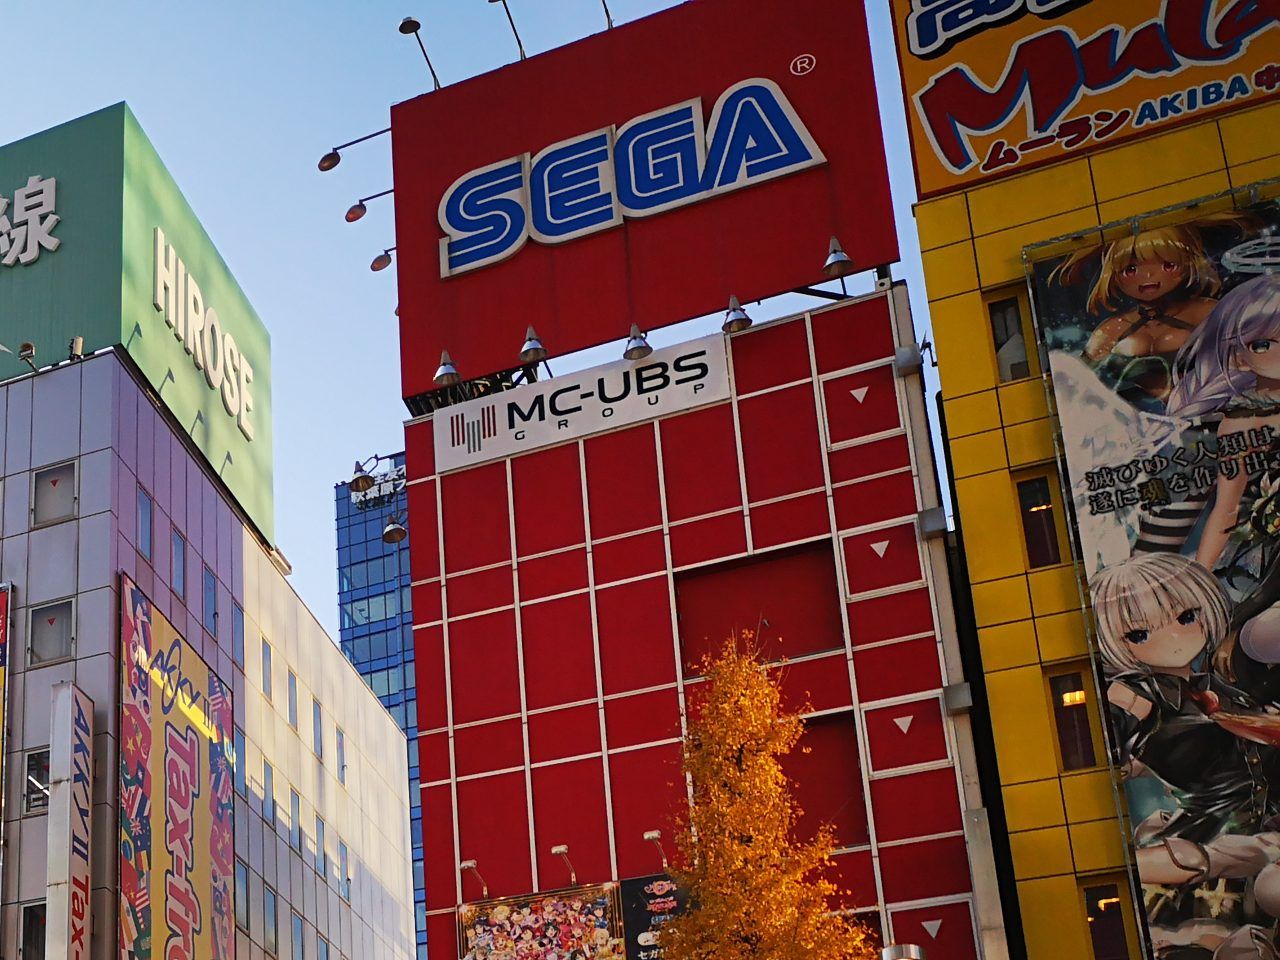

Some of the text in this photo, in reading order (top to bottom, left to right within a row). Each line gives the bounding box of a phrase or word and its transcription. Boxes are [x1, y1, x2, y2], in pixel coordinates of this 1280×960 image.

[981, 109, 1131, 172] ムーラン
[1136, 75, 1250, 126] AKIBA
[438, 78, 827, 279] SEGA
[154, 227, 254, 442] HIROSE
[507, 350, 709, 430] MC-UBS
[514, 383, 706, 441] GROUP
[1087, 426, 1275, 491] 滅びゆく人類は
